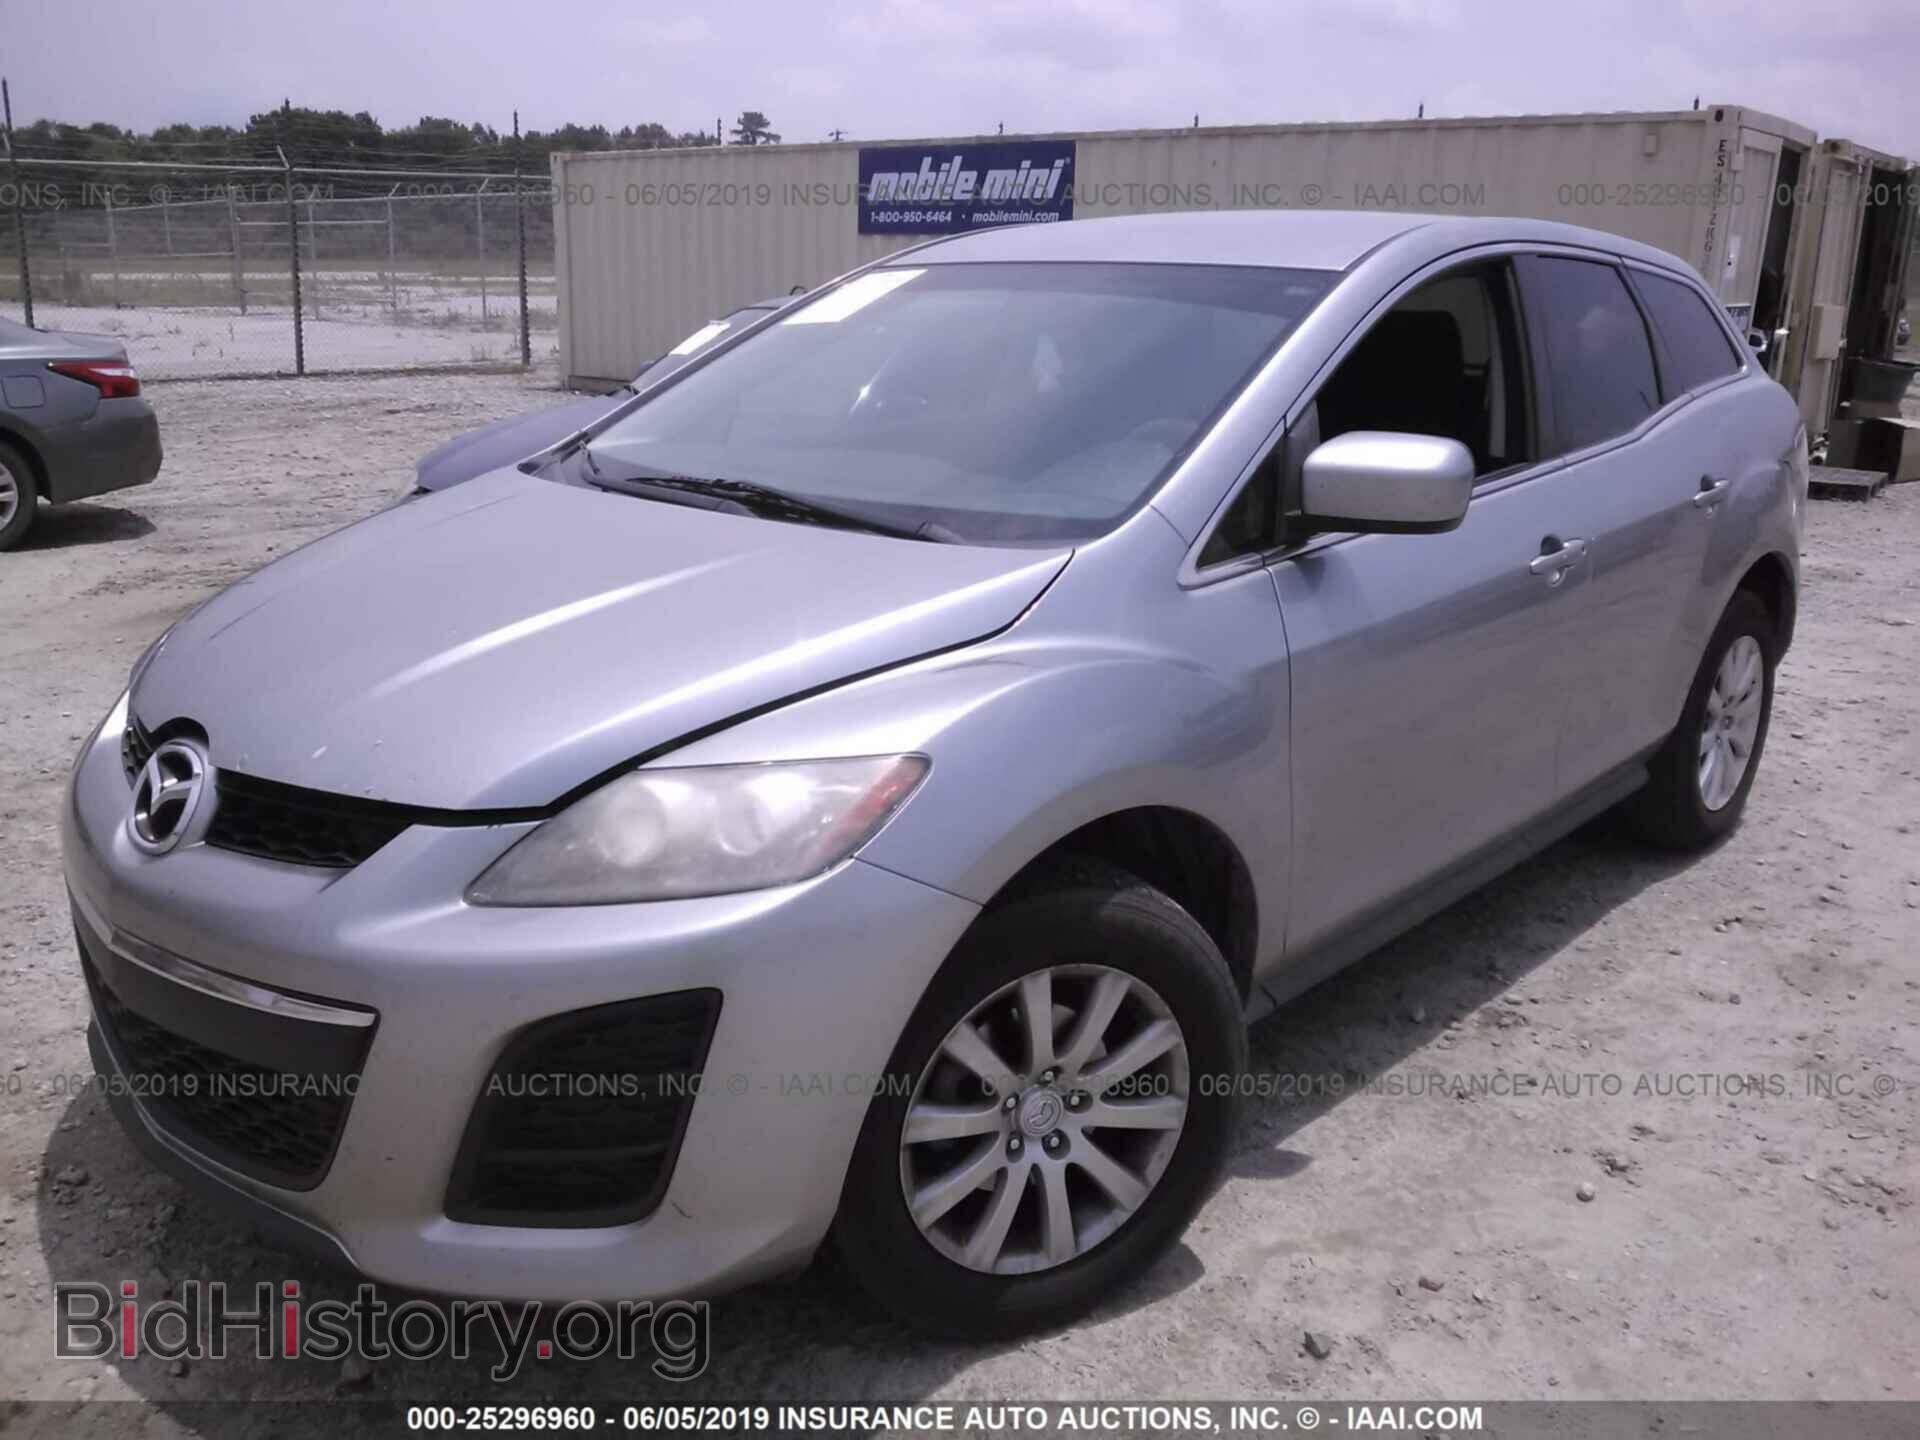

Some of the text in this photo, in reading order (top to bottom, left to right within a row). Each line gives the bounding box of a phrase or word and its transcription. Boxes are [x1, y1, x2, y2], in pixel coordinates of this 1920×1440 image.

[867, 155, 1065, 201] mobile mini
[871, 211, 1060, 223] 1-800-950-6464 mobilemini.com
